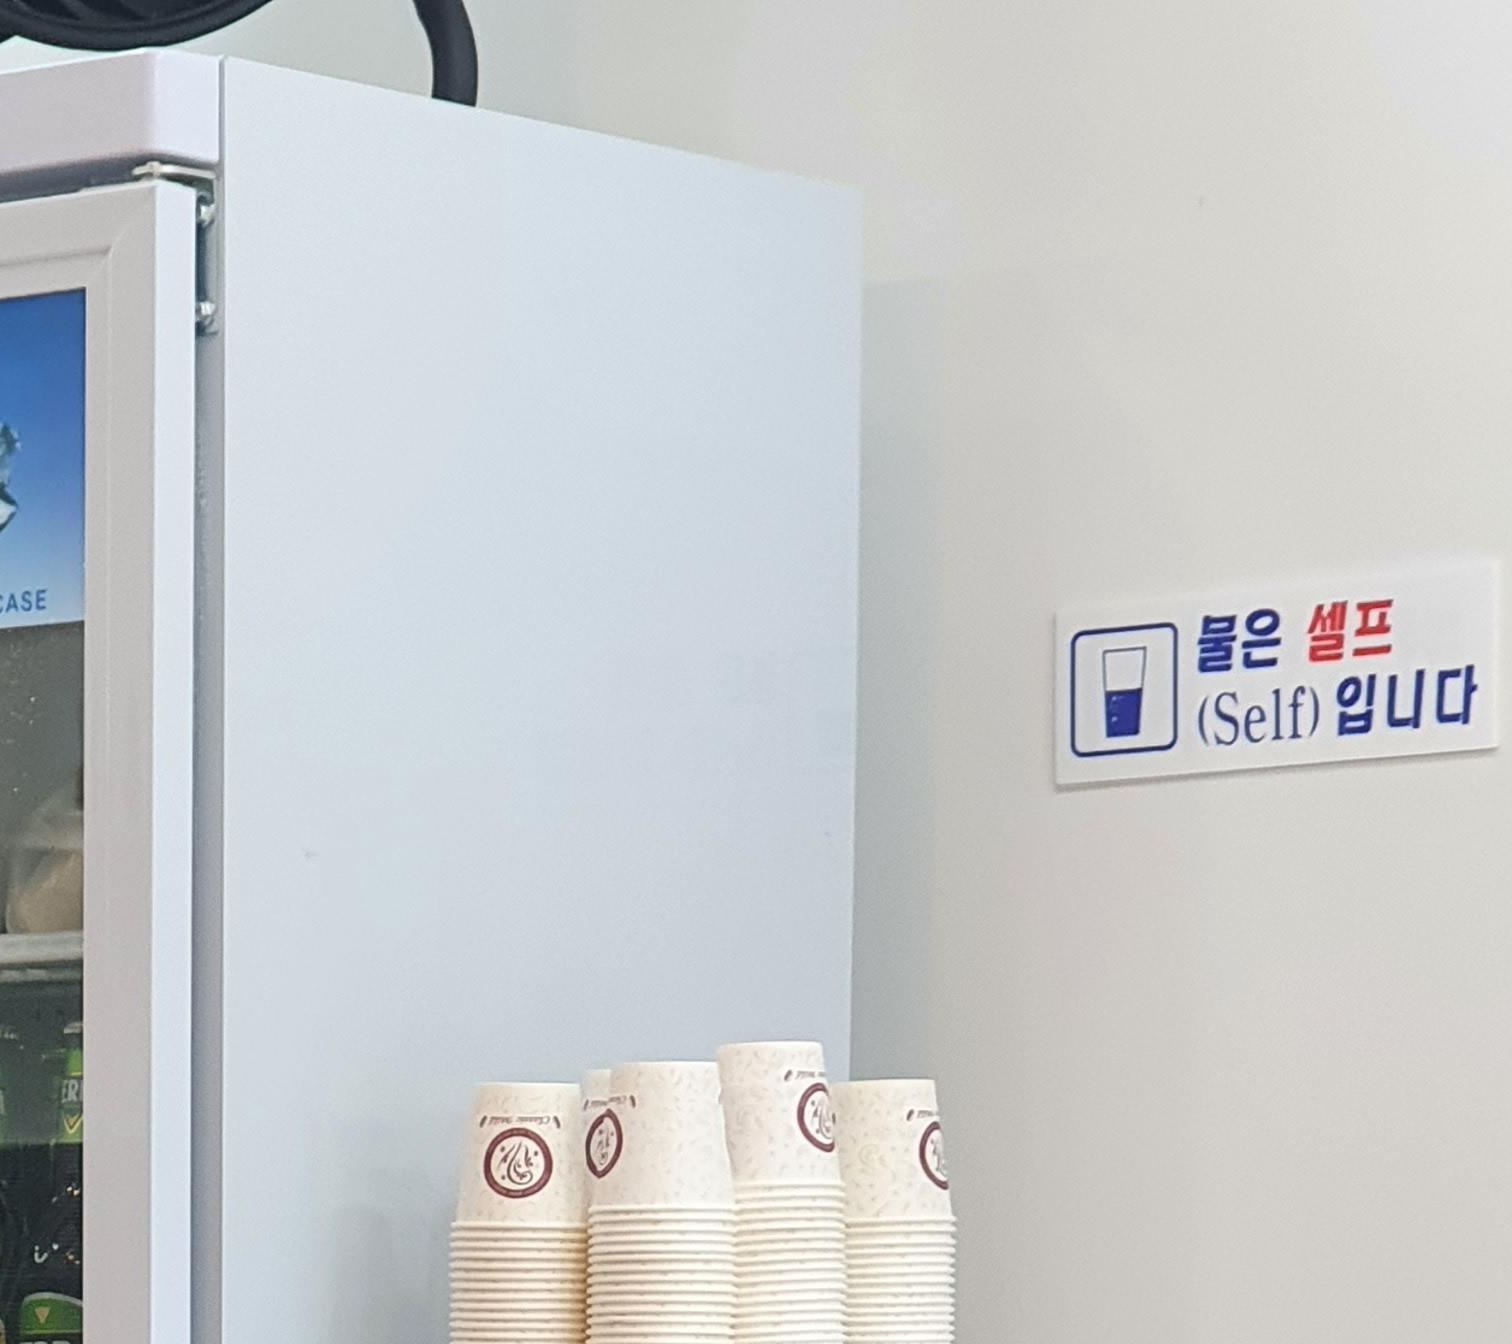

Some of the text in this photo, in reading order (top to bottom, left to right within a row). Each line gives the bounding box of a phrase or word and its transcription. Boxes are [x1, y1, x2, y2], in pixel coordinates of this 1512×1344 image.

[1197, 599, 1394, 673] 물은 셀프
[1198, 665, 1478, 748] (Self) 입니다
